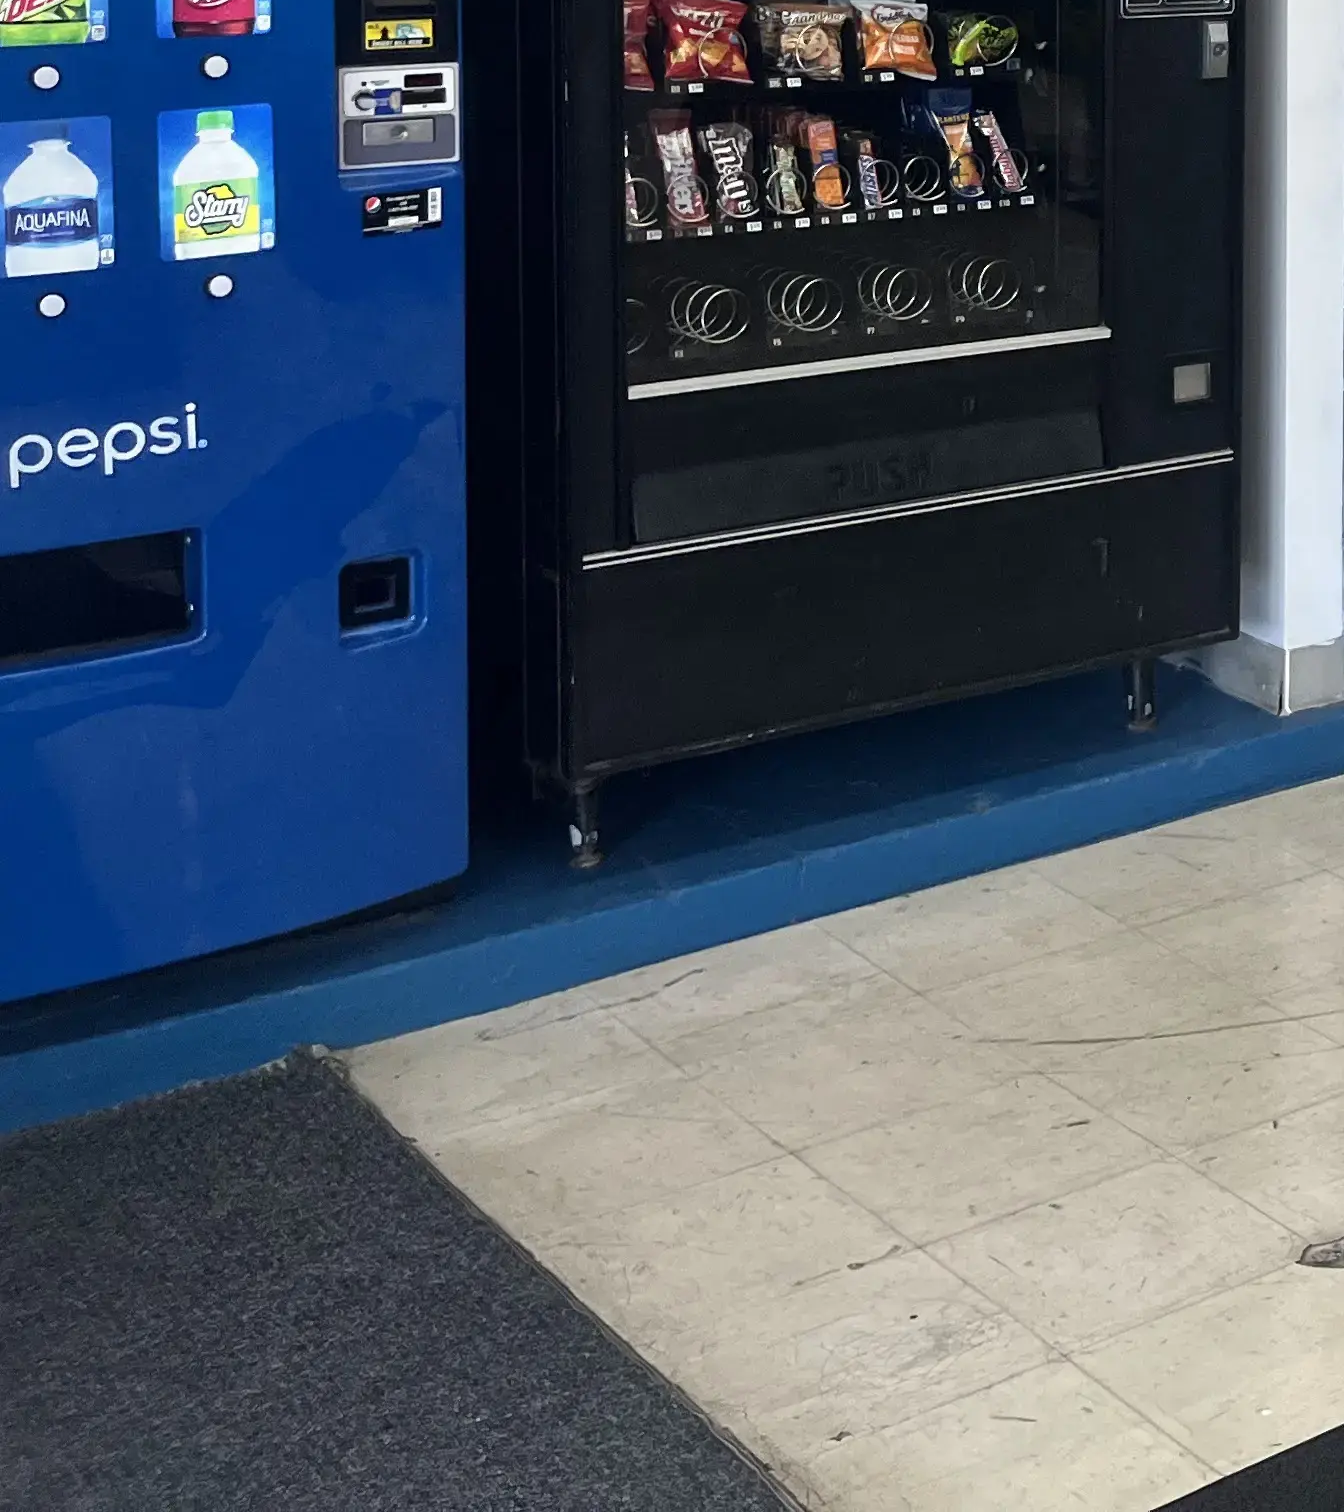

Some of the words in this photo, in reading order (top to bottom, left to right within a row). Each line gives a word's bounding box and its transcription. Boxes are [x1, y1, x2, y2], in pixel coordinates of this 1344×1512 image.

[14, 208, 92, 236] AQUAFINA
[184, 190, 249, 228] Starry
[8, 401, 198, 489] pepsi
